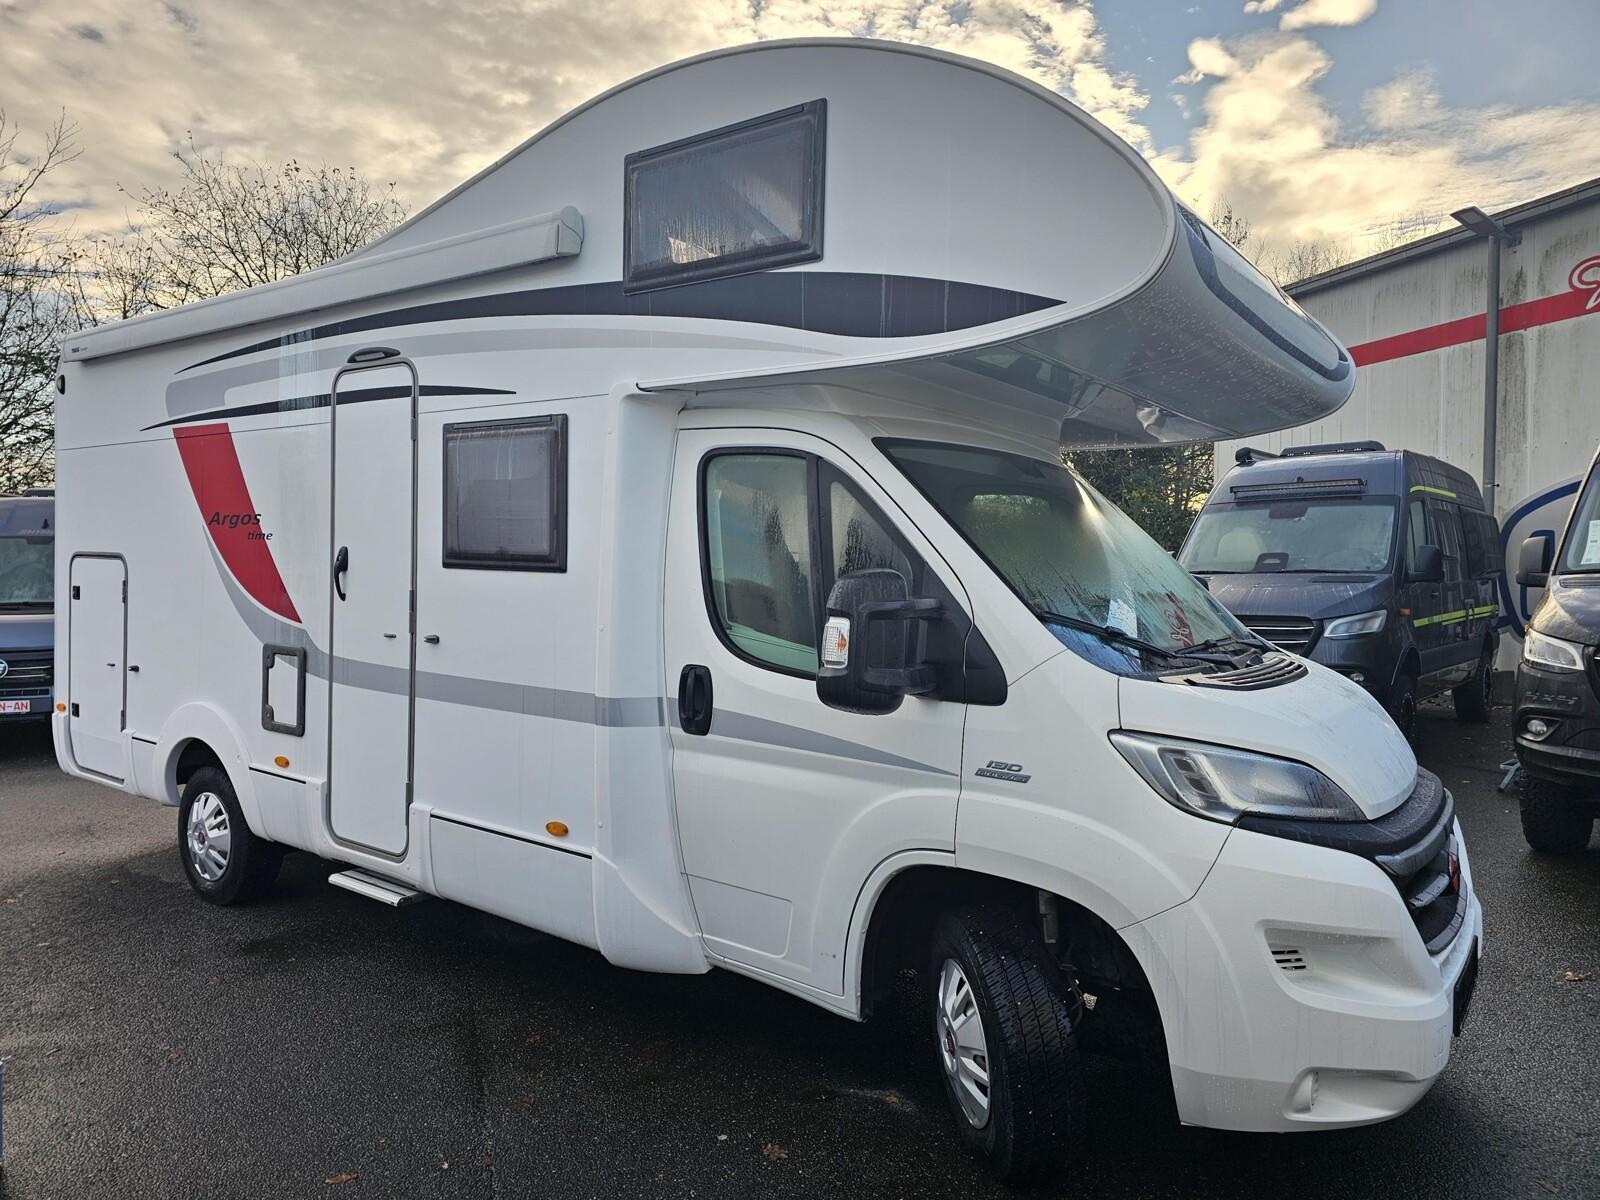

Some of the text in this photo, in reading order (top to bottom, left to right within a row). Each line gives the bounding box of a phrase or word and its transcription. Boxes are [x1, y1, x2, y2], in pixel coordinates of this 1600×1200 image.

[208, 511, 262, 529] Argos
[247, 531, 273, 541] time
[985, 760, 1023, 772] 130
